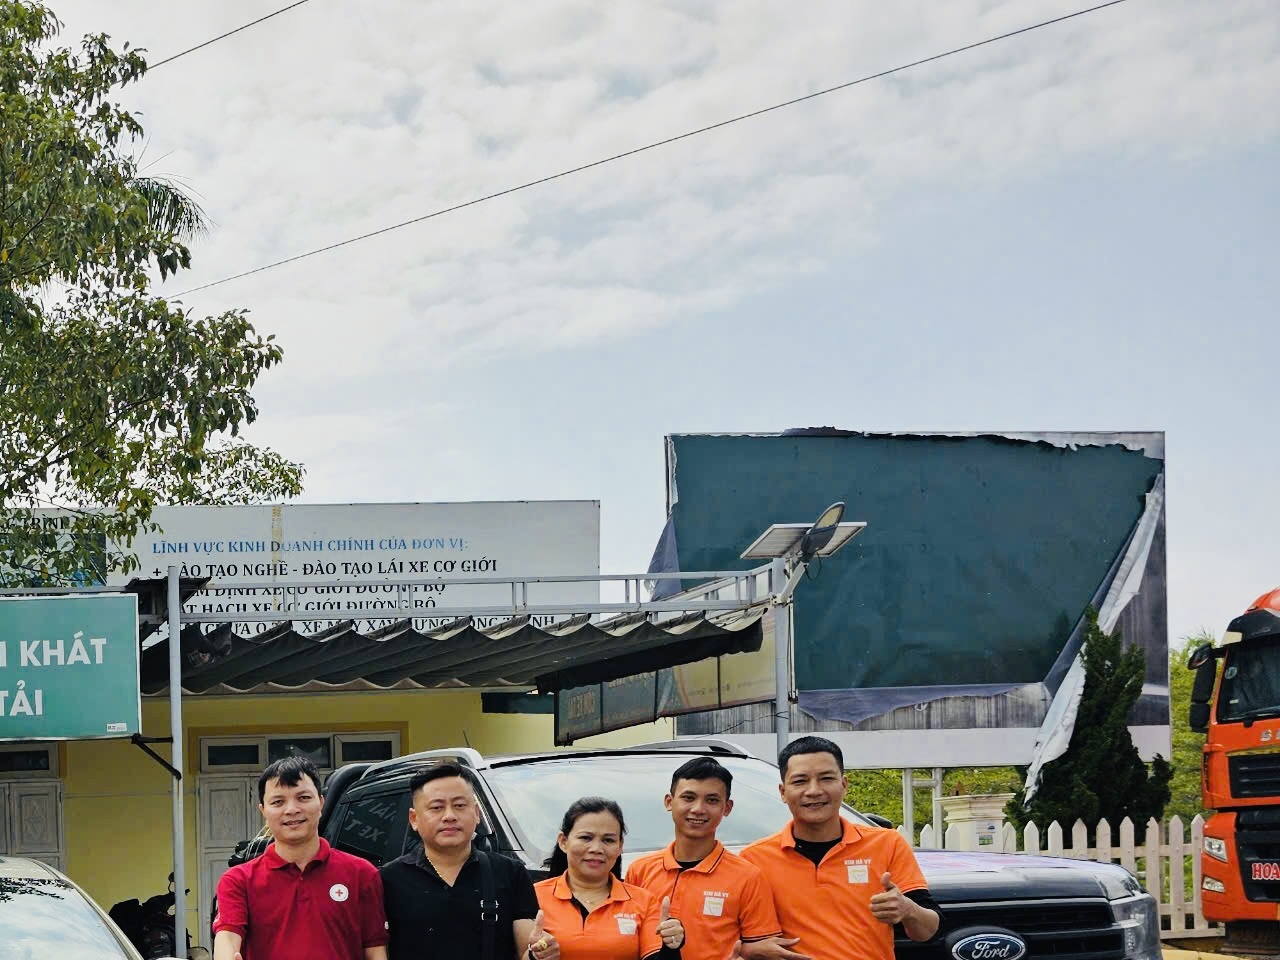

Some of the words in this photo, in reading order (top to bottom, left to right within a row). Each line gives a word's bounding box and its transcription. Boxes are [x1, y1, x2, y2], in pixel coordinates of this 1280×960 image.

[153, 540, 188, 553] LĨNH
[194, 541, 224, 555] VỰC
[228, 541, 265, 553] KINH
[328, 537, 374, 551] CHÍNH
[412, 538, 445, 549] ĐƠN
[168, 562, 201, 577] ÀO
[206, 564, 237, 580] TẠO
[243, 560, 288, 576] NGHỀ
[302, 560, 336, 576] ĐÀO
[341, 562, 373, 577] TẠO
[378, 558, 403, 574] LÁI
[408, 561, 428, 573] XE
[433, 560, 457, 573] CƠ
[461, 557, 497, 572] GIỚI
[302, 621, 323, 634] XE
[20, 630, 107, 668] KHÁT
[972, 940, 1010, 960] Ford
